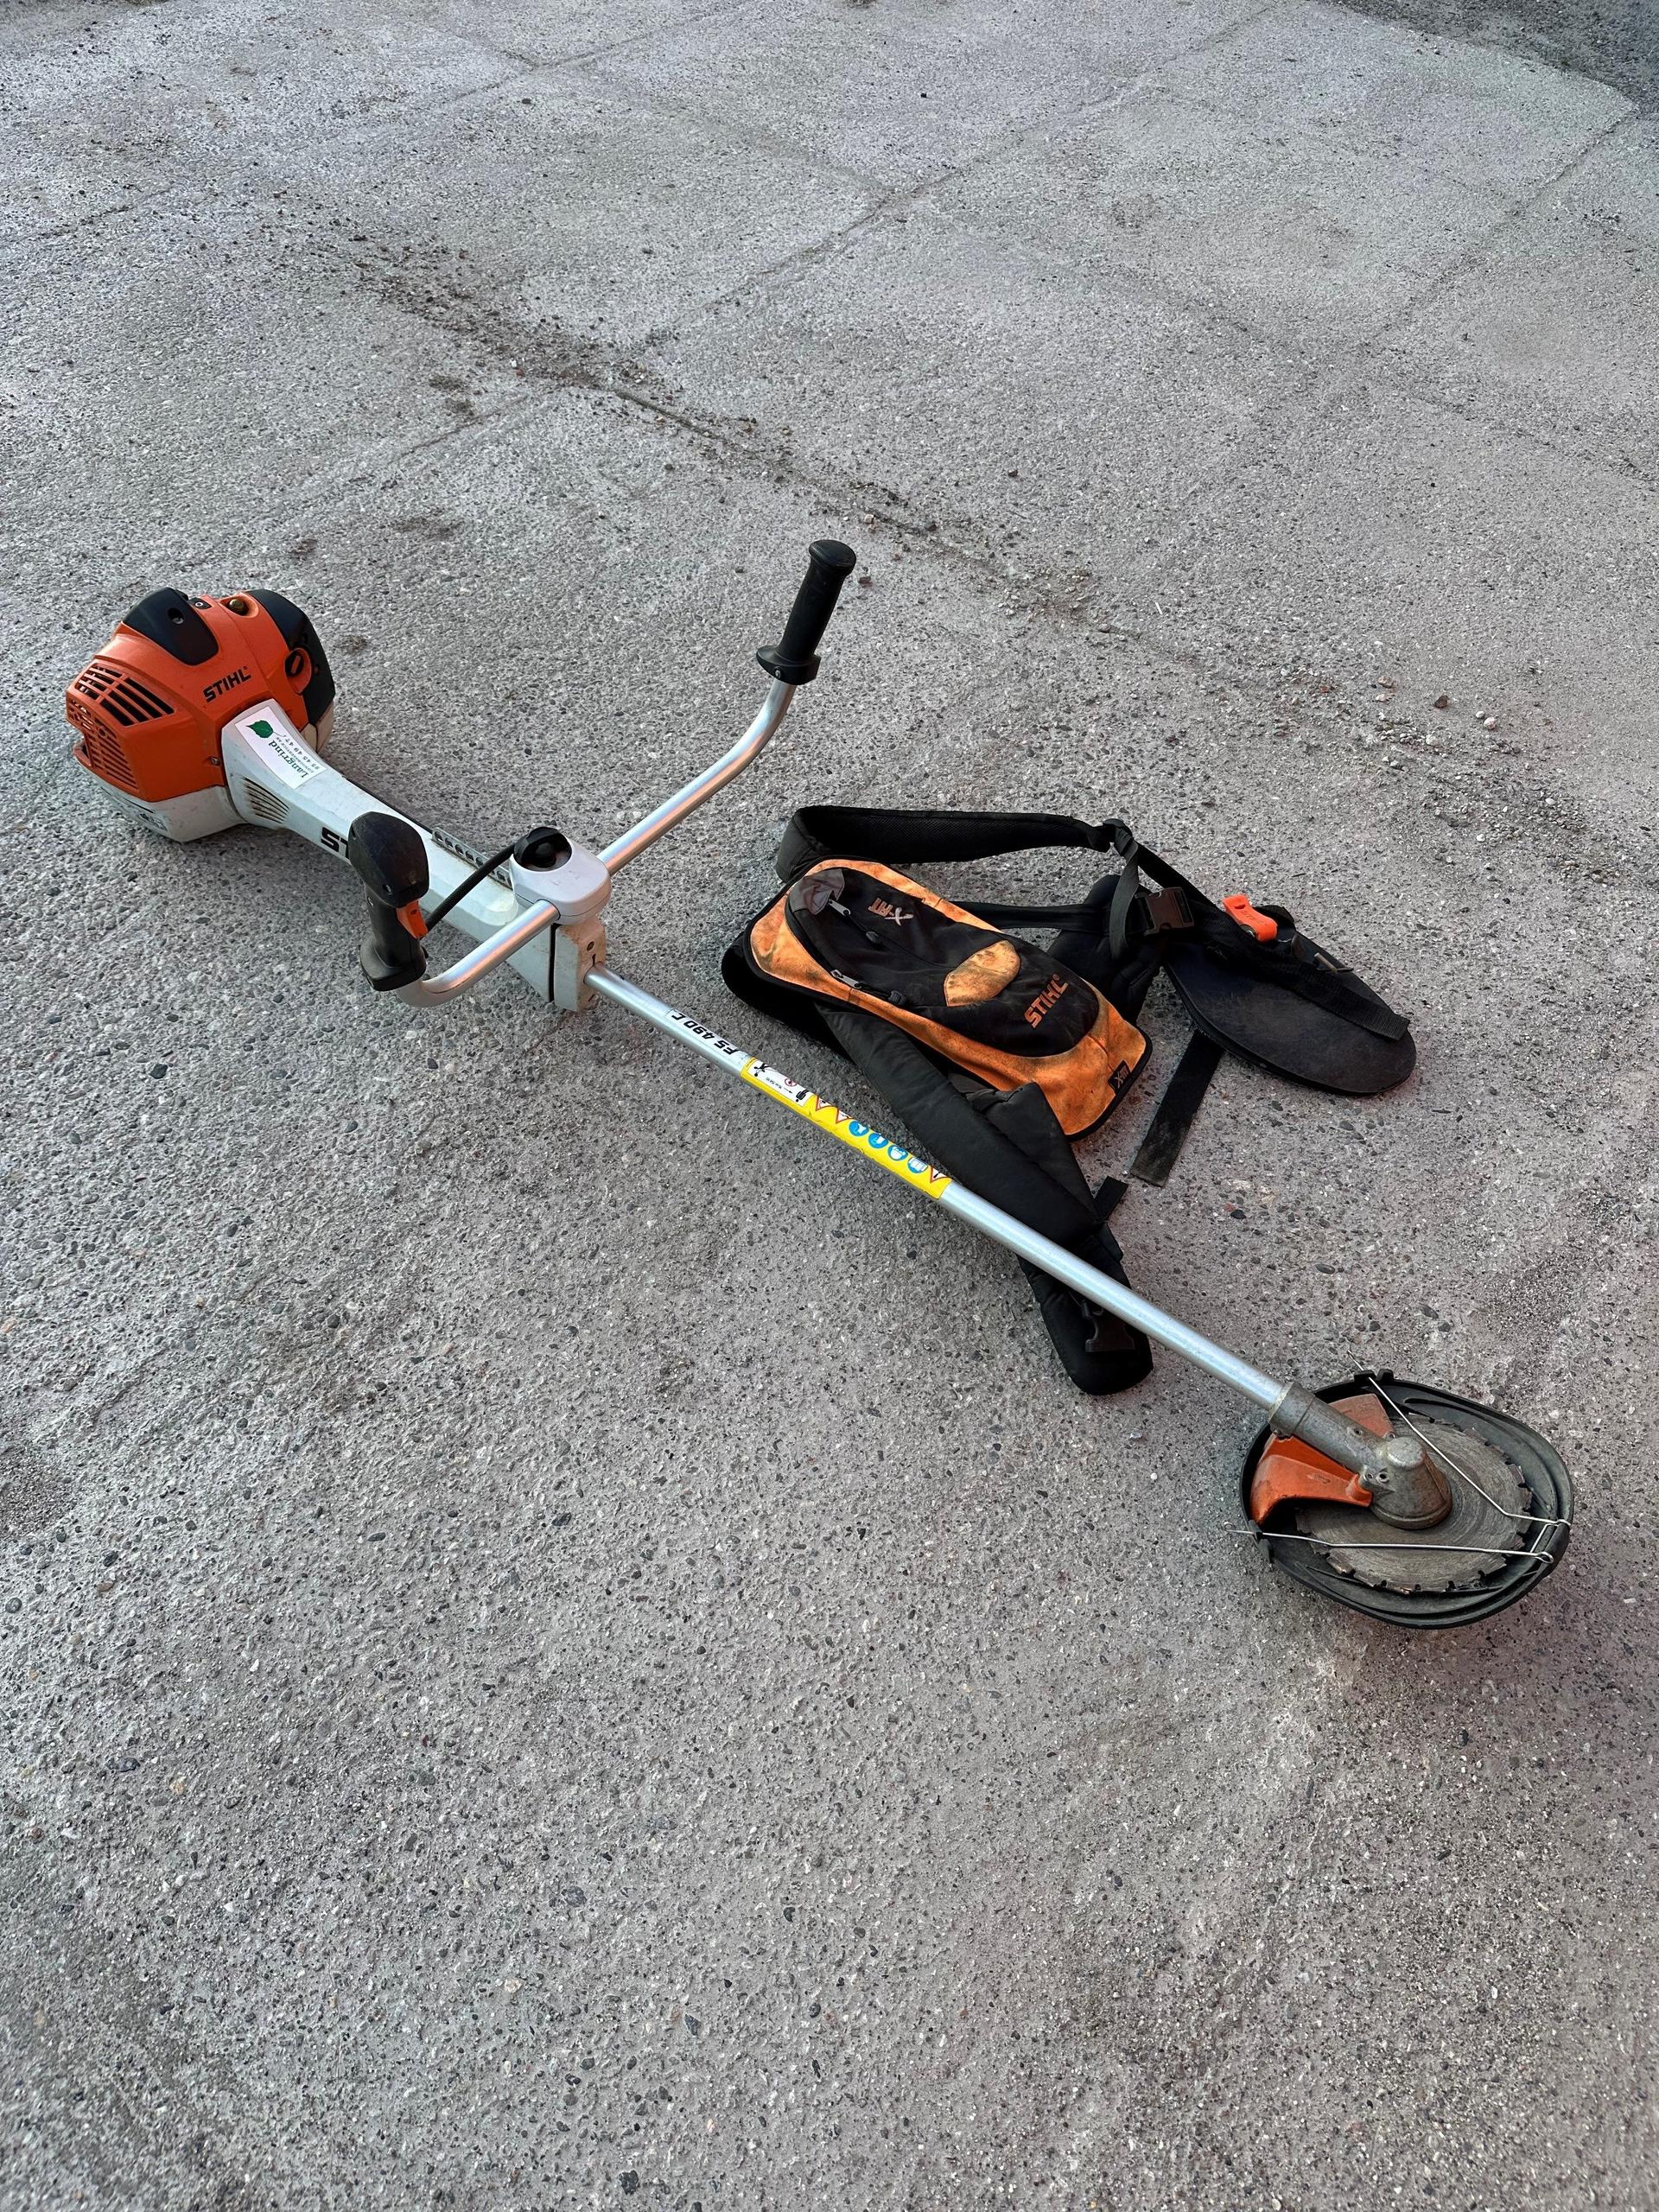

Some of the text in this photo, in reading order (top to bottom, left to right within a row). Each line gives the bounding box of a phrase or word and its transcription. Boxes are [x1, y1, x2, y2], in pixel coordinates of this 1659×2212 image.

[203, 669, 251, 703] STIHL
[268, 740, 309, 778] Langrind
[1024, 979, 1069, 1028] STIHL
[683, 1020, 715, 1039] 490
[713, 1039, 740, 1055] FS
